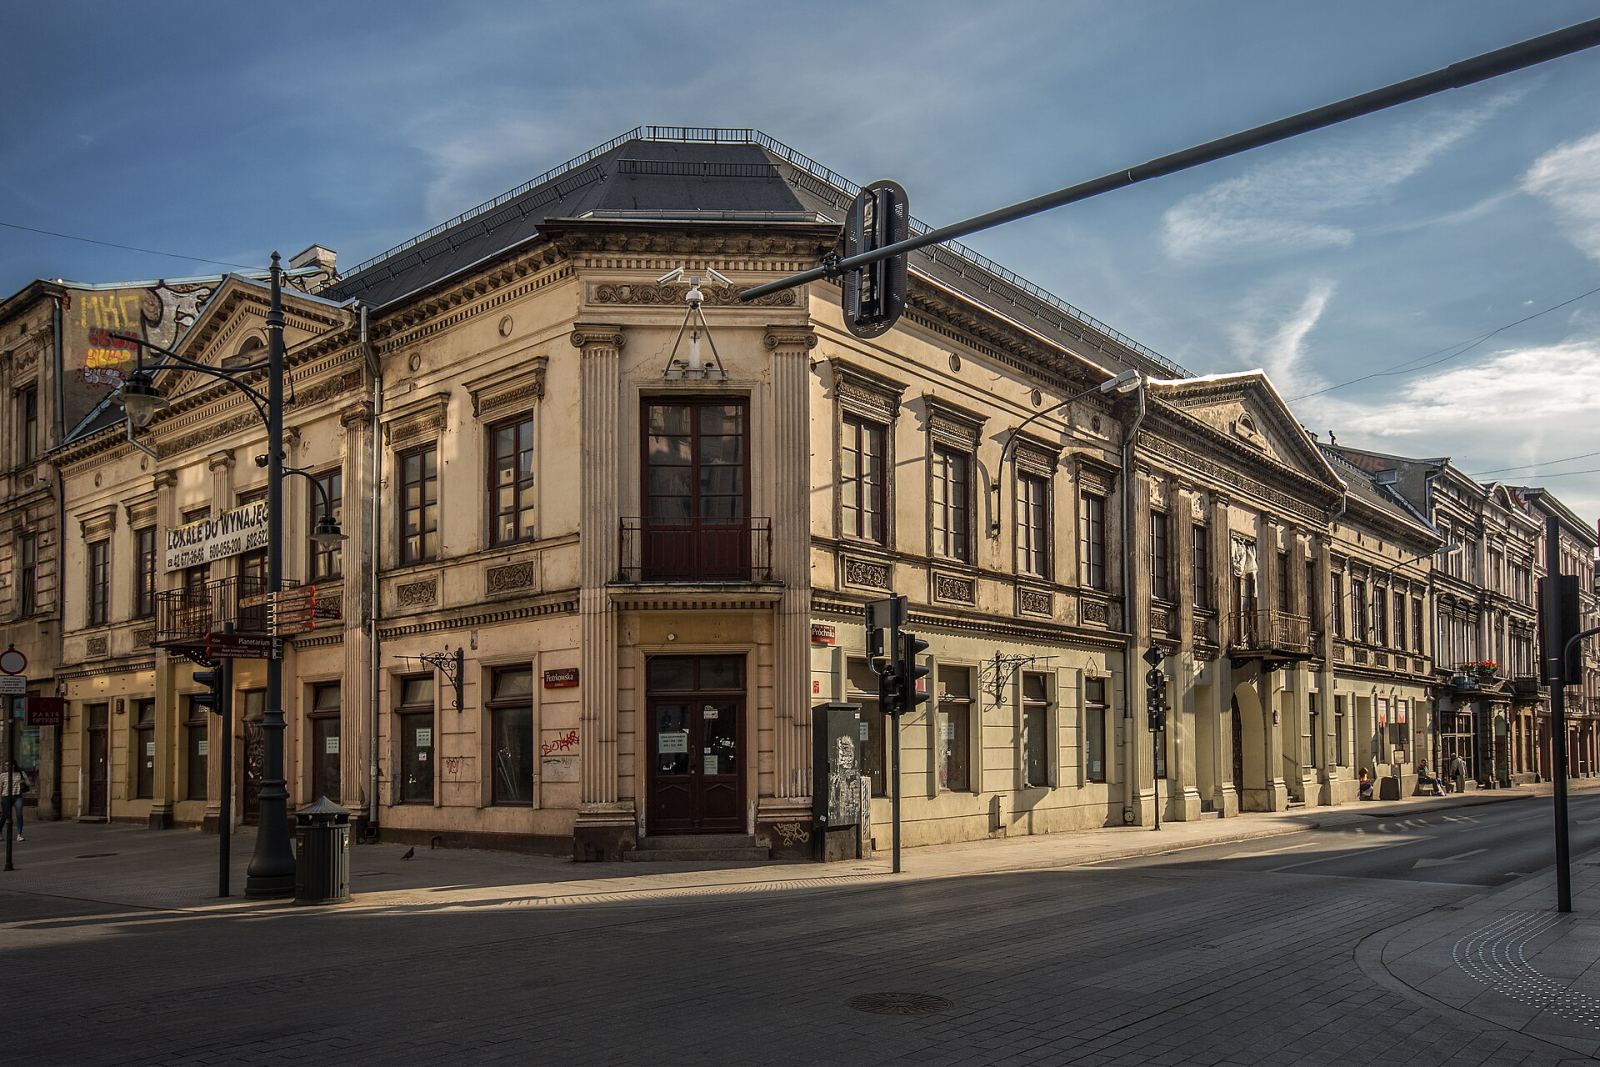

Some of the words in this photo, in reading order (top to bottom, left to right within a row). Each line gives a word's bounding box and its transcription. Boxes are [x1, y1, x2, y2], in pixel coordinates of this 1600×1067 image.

[167, 526, 203, 550] LOKALE
[205, 521, 218, 540] DO
[221, 502, 268, 535] WYNAJĘC
[238, 637, 270, 646] Planetarium
